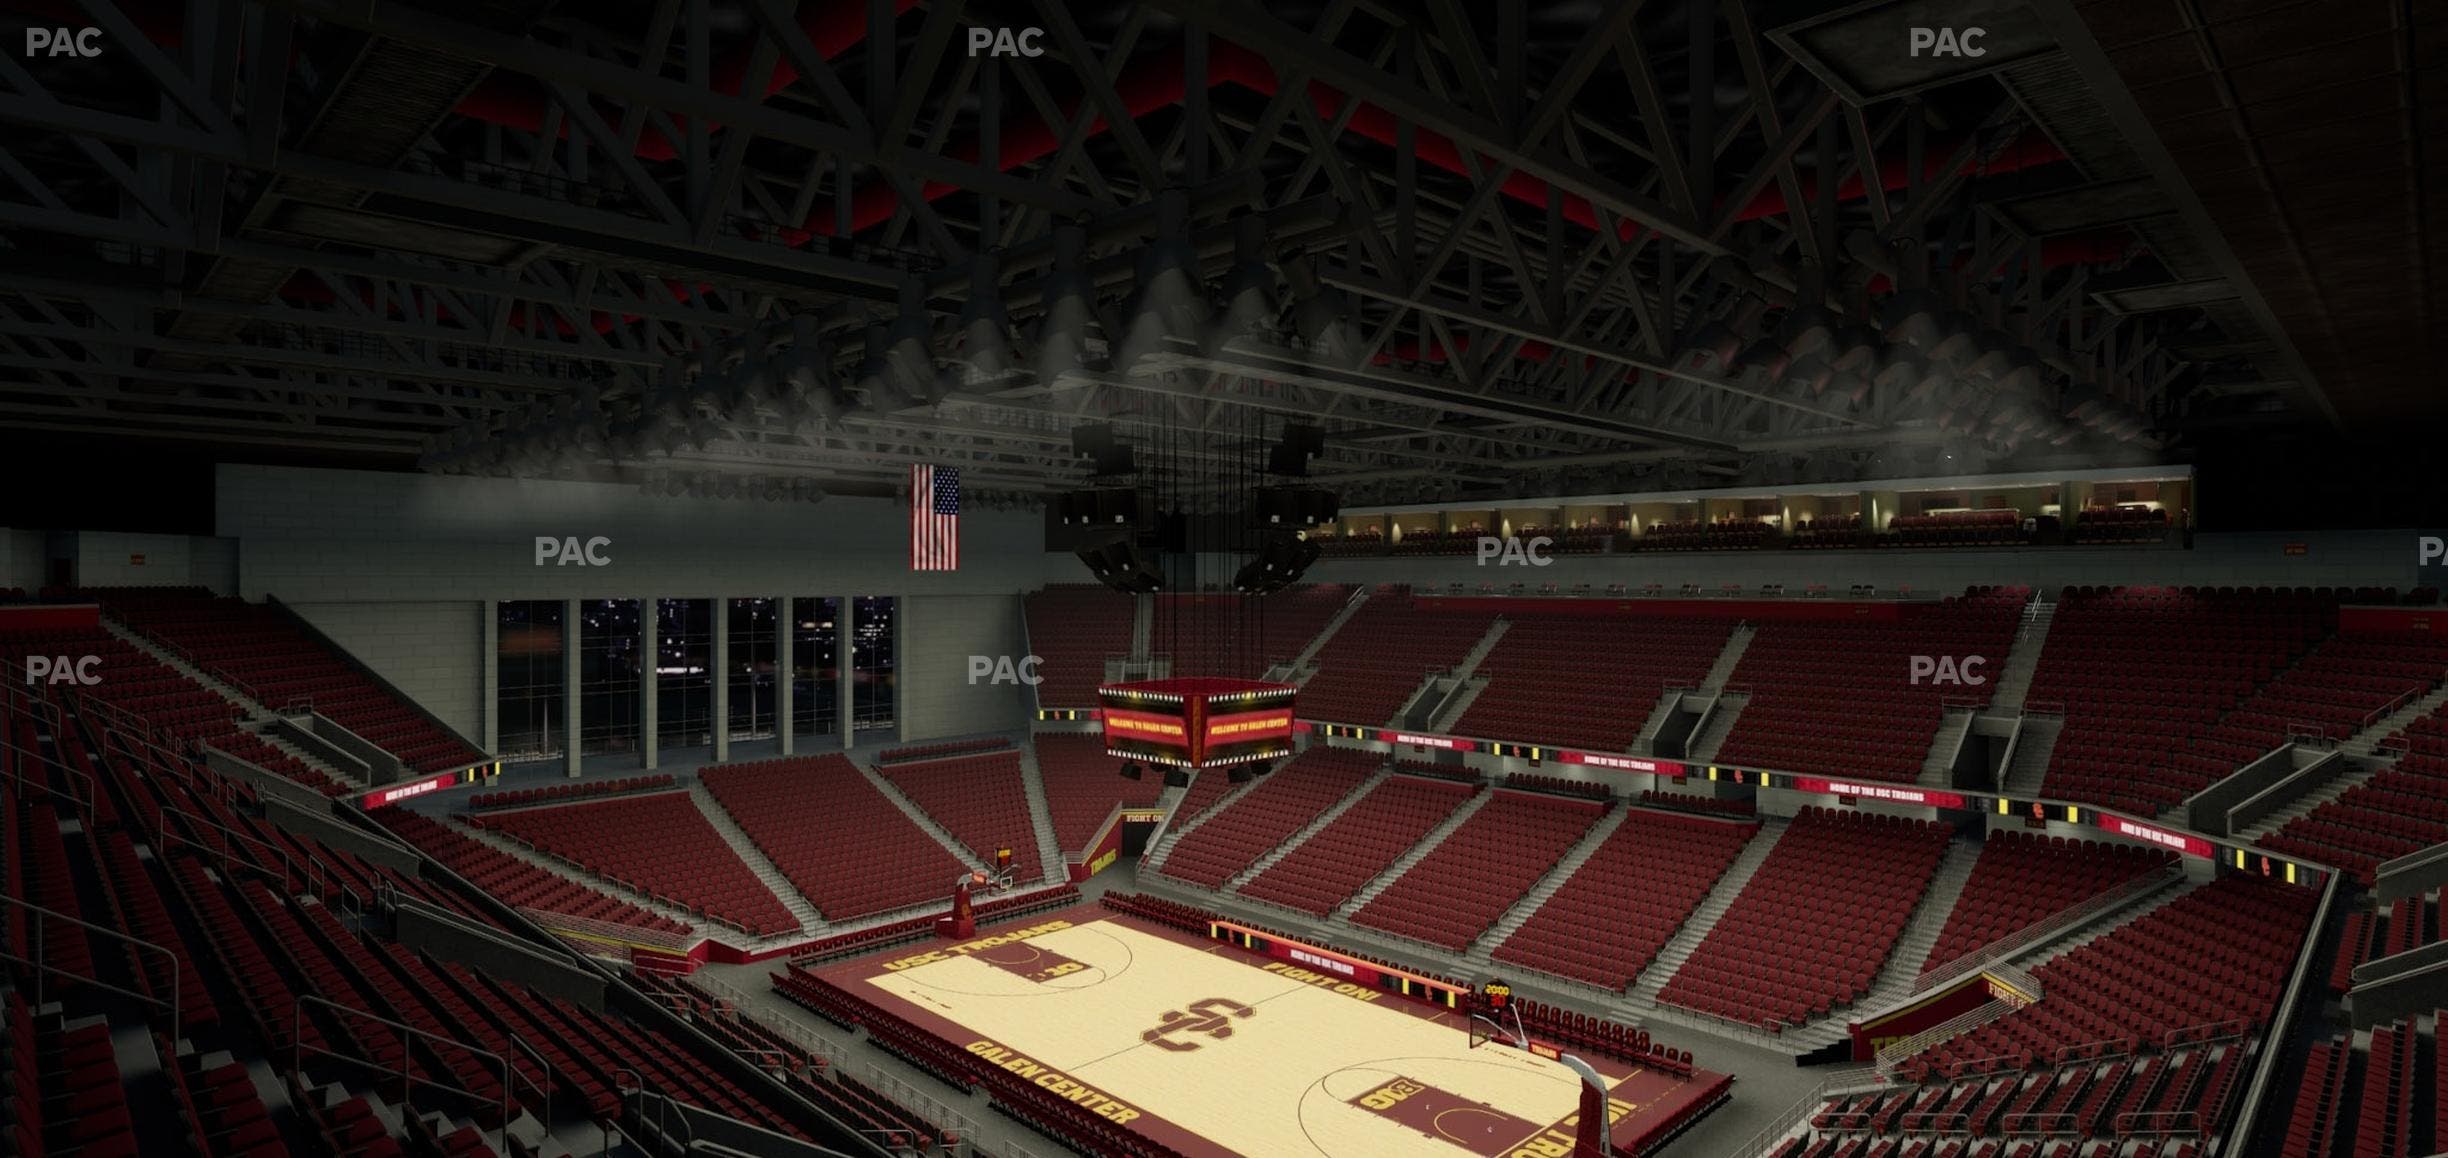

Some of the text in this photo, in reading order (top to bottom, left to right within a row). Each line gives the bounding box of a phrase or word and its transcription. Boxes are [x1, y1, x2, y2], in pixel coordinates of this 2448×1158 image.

[1829, 783, 1924, 802] HOME OF THE USC TROJANS
[882, 919, 1074, 971] USC TROJANS
[1262, 962, 1340, 986] FIGHT
[964, 1040, 1141, 1126] GALEN CENTER
